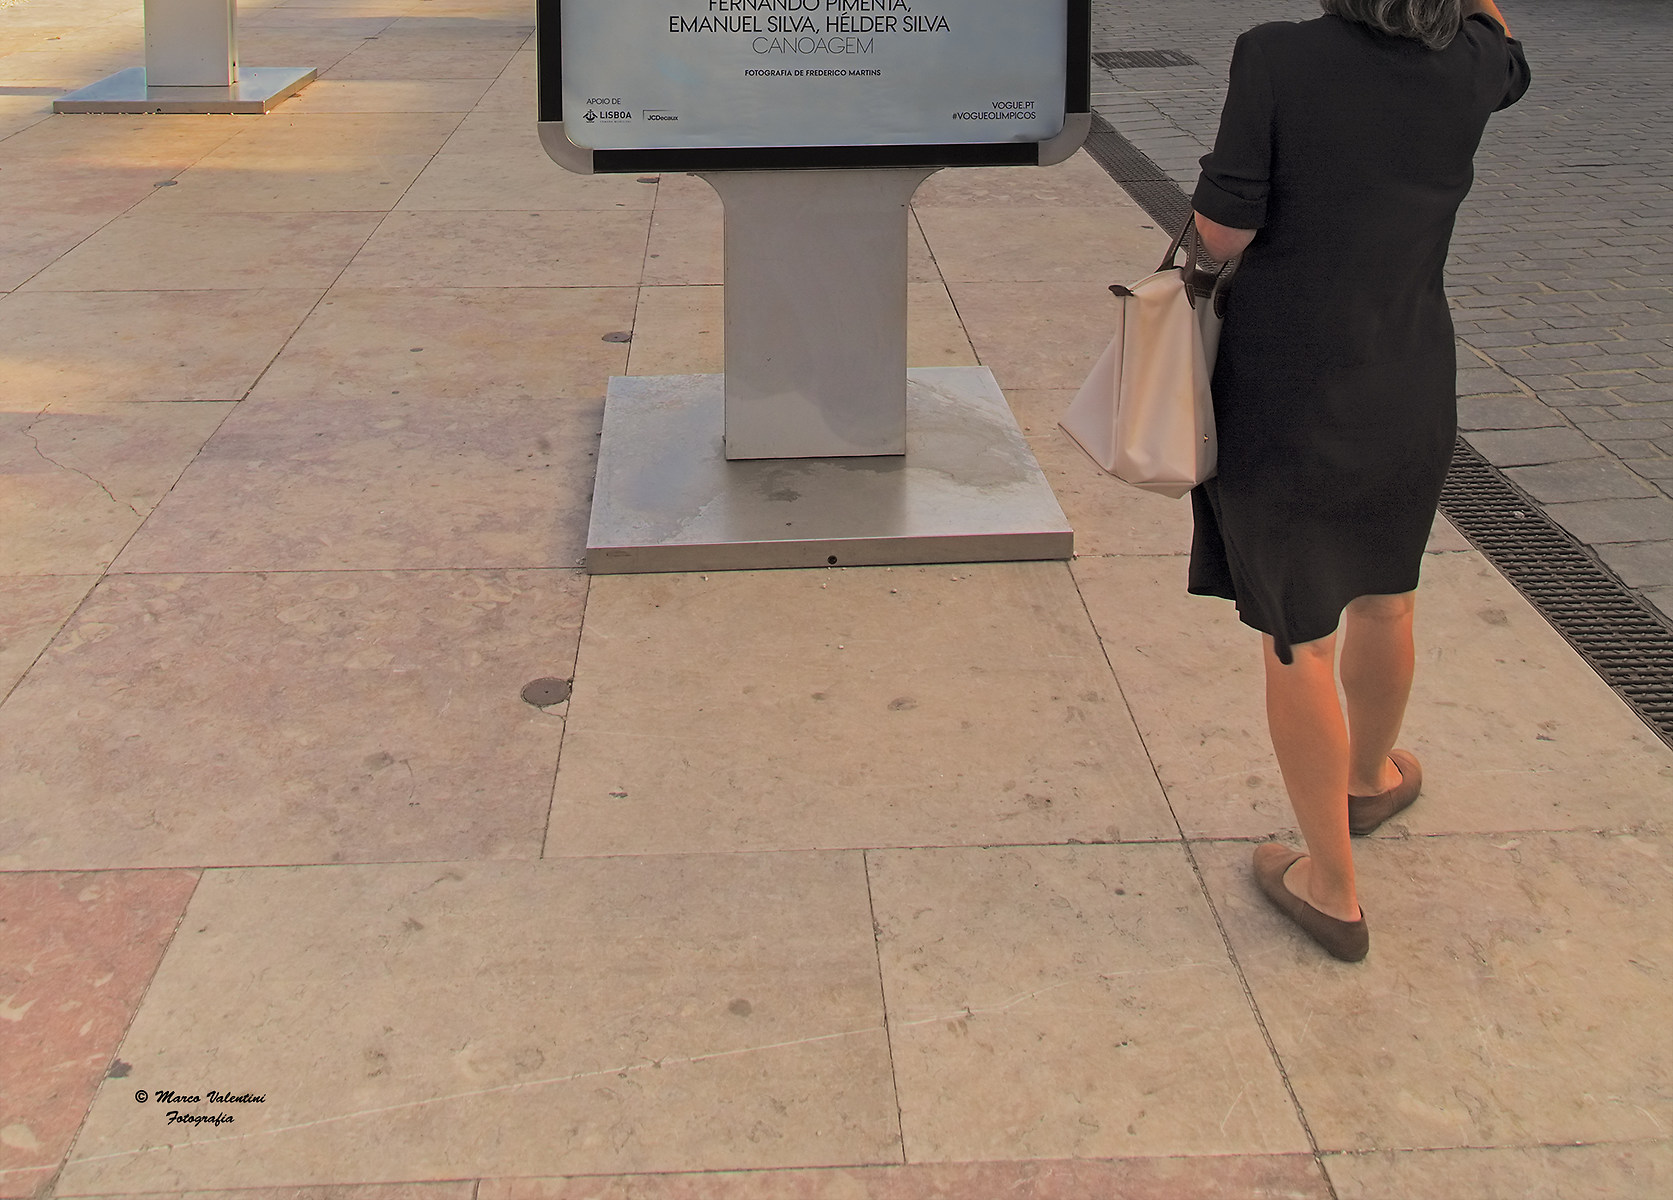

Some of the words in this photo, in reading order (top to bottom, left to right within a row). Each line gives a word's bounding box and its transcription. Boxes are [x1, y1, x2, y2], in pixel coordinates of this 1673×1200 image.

[669, 15, 763, 33] EMANUEL
[767, 15, 820, 34] SILVA,
[826, 11, 897, 33] HÉLDER
[902, 15, 951, 33] SILVA
[752, 36, 874, 55] CANOAGEM
[744, 69, 792, 77] FOTOGRAFIA
[794, 69, 804, 77] DE
[805, 69, 847, 77] FREDERICO
[848, 69, 882, 77] MARTINS
[992, 101, 1034, 110] VOGUE.PT
[599, 111, 632, 119] LISBOA
[952, 111, 1036, 120] #VOGUEOLIMPICOS
